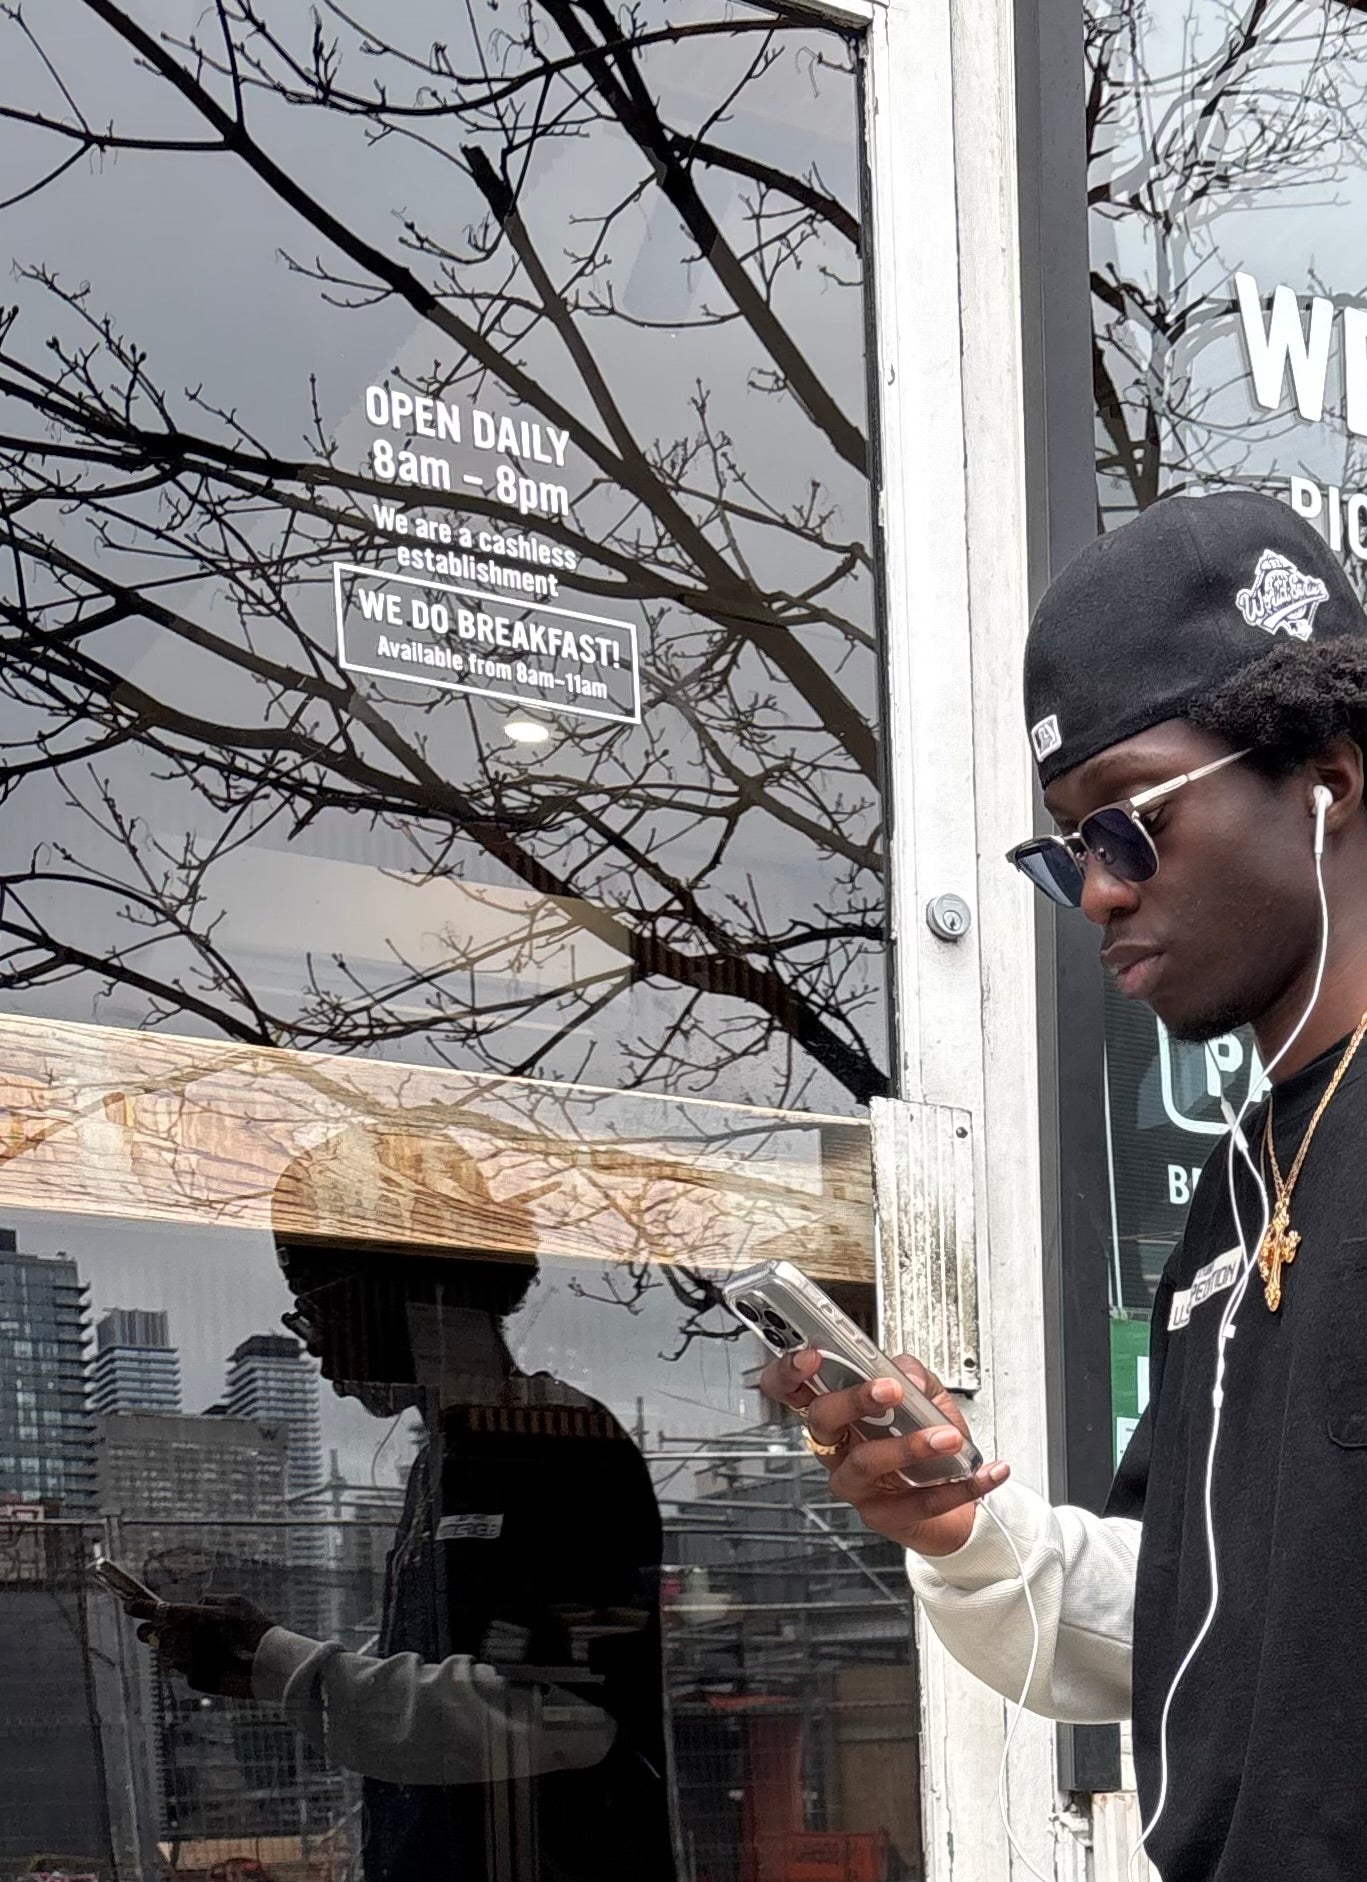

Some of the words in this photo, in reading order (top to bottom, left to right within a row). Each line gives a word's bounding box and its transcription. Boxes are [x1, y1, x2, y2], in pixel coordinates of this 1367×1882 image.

[365, 386, 461, 443] OPEN
[473, 409, 570, 466] DAILY
[372, 439, 450, 490] 8am
[496, 465, 569, 516] 8pm
[373, 503, 408, 534] We
[415, 518, 451, 543] are
[459, 528, 473, 547] a
[479, 529, 577, 570] cashless
[397, 546, 559, 597] establishment
[358, 588, 403, 625] WE
[411, 600, 449, 634] DO
[458, 610, 621, 669] BREAKFAST!
[377, 635, 463, 672] Available
[468, 653, 512, 680] from
